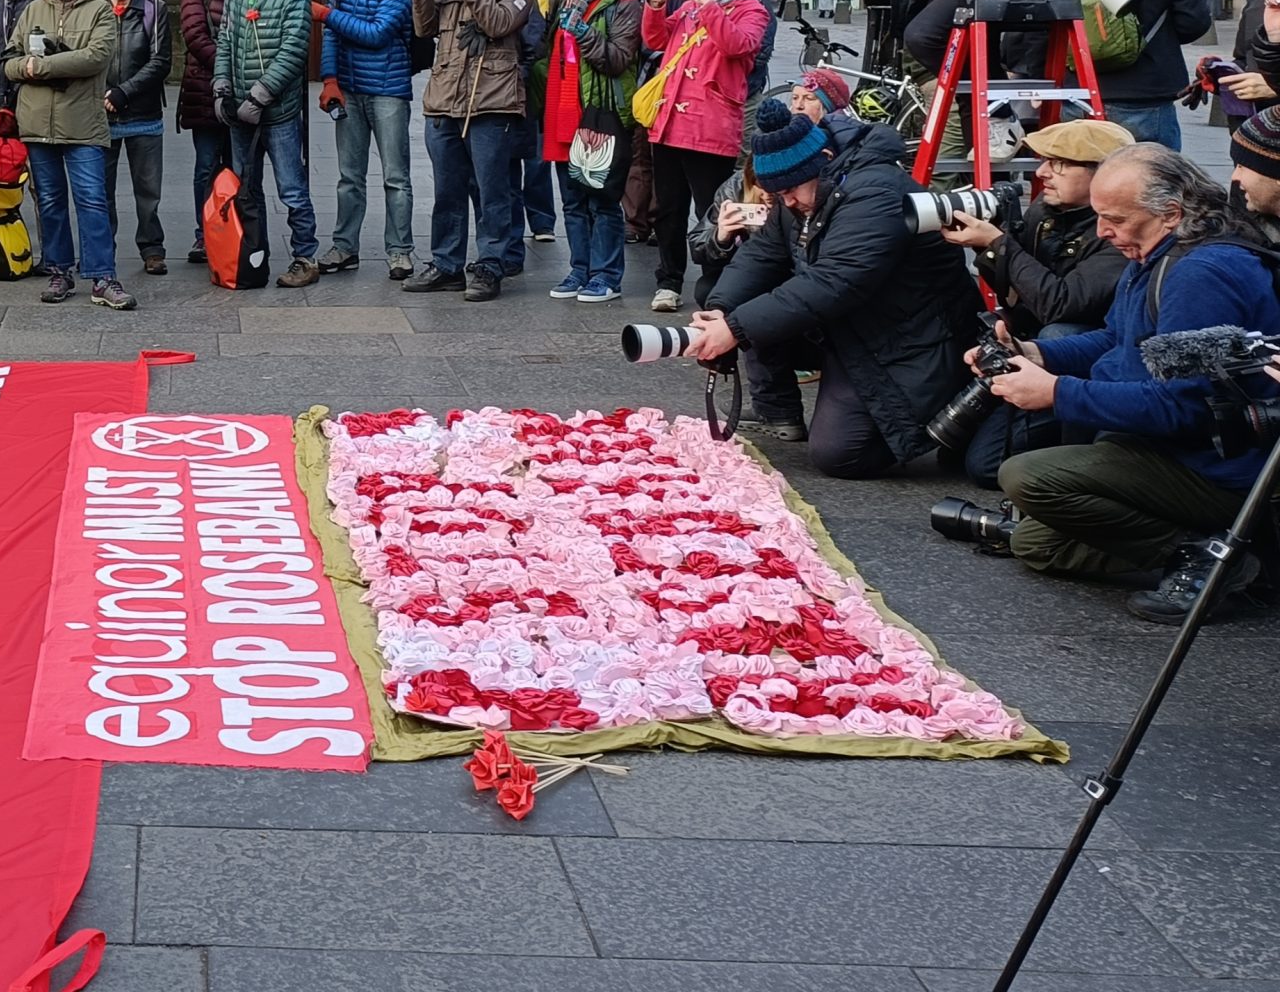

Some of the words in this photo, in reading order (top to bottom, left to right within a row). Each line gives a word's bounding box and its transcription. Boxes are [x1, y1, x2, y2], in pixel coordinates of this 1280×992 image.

[82, 466, 185, 542] MUST
[188, 461, 326, 626] ROSEBANK
[65, 543, 192, 747] equinor
[211, 636, 366, 757] STOP
